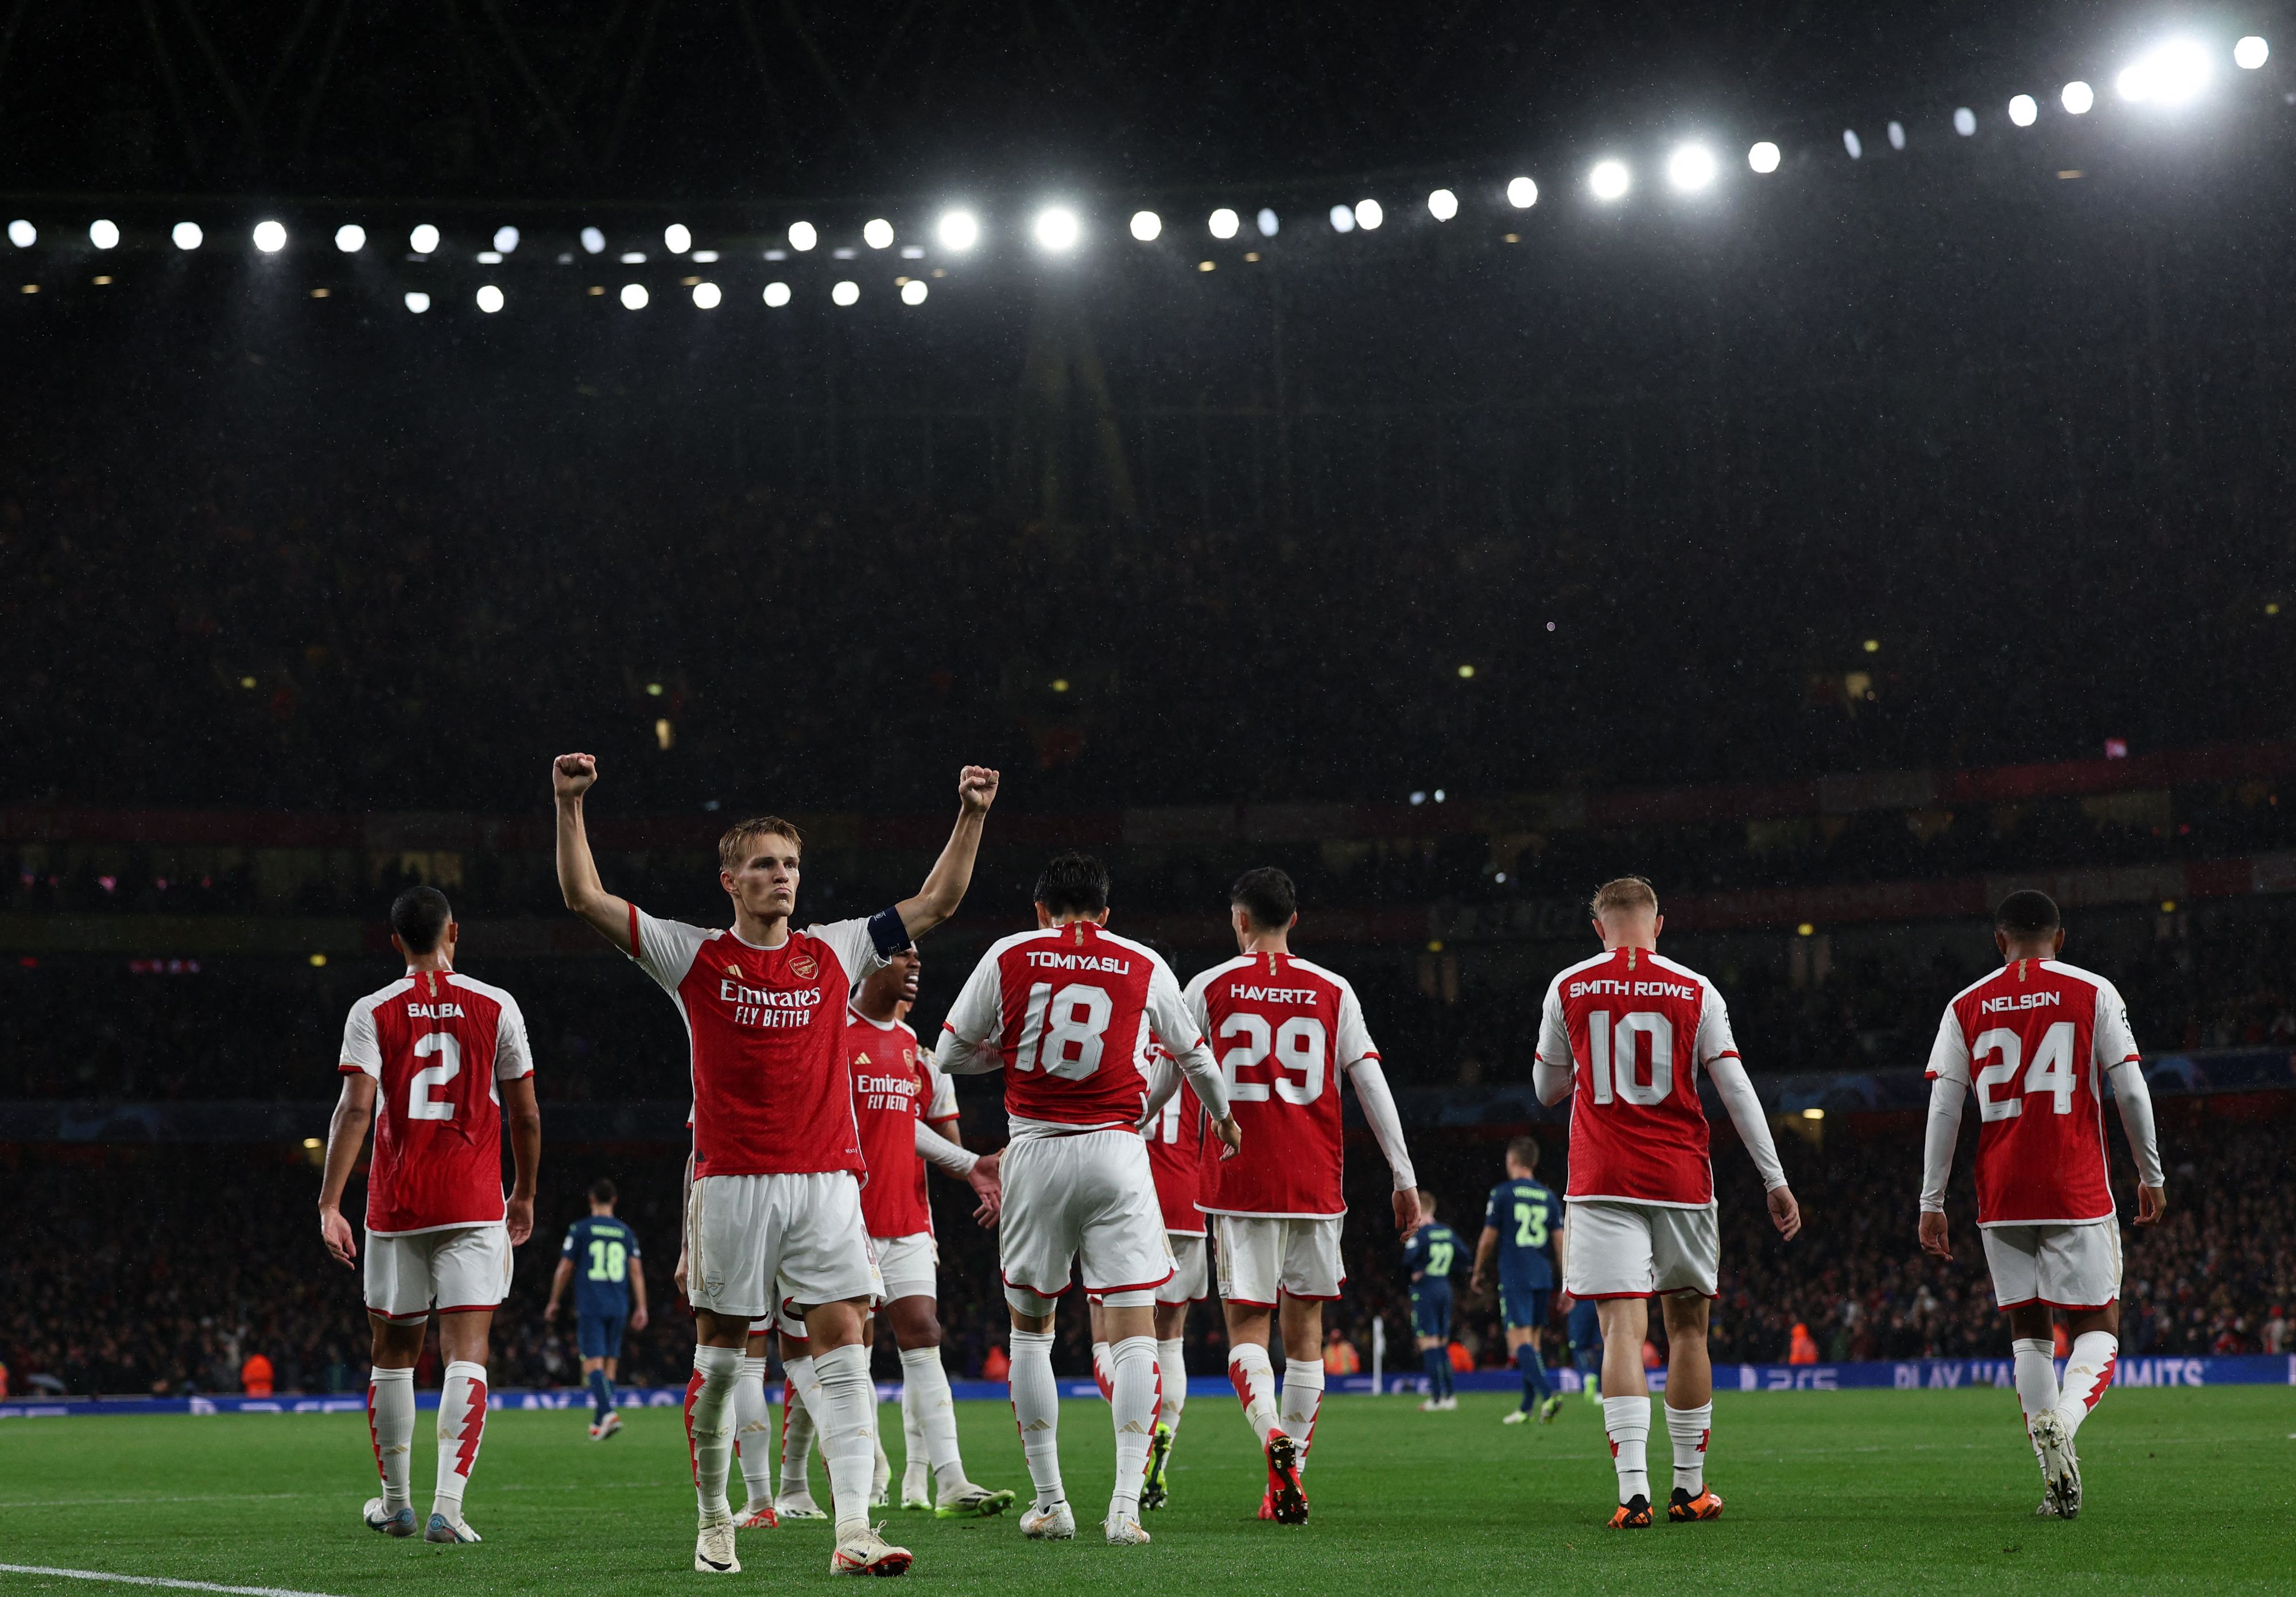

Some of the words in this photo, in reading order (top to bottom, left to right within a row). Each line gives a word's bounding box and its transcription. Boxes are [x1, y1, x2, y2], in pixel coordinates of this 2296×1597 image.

[793, 959, 810, 967] Arsenal
[1026, 951, 1130, 975] TOMIYASU
[720, 979, 821, 1007] Emirates
[1231, 984, 1317, 1005] HAVERTZ
[1570, 980, 1630, 998] SMITH
[1634, 981, 1694, 1000] ROWE
[1981, 991, 2060, 1015] NELSON
[408, 1003, 465, 1019] SALIBA
[735, 1006, 759, 1025] FLY
[763, 1009, 810, 1028] BETTER
[1014, 982, 1114, 1081] 18
[1220, 1012, 1327, 1106] 29
[1589, 1010, 1673, 1106] 10
[1972, 1021, 2077, 1123] 24
[408, 1032, 461, 1121] 2
[857, 1073, 914, 1097] Emirates
[867, 1094, 884, 1109] FLY
[1514, 1202, 1549, 1249] 23
[587, 1239, 626, 1283] 18
[1425, 1242, 1454, 1276] 22
[2113, 1357, 2205, 1388] IMITS
